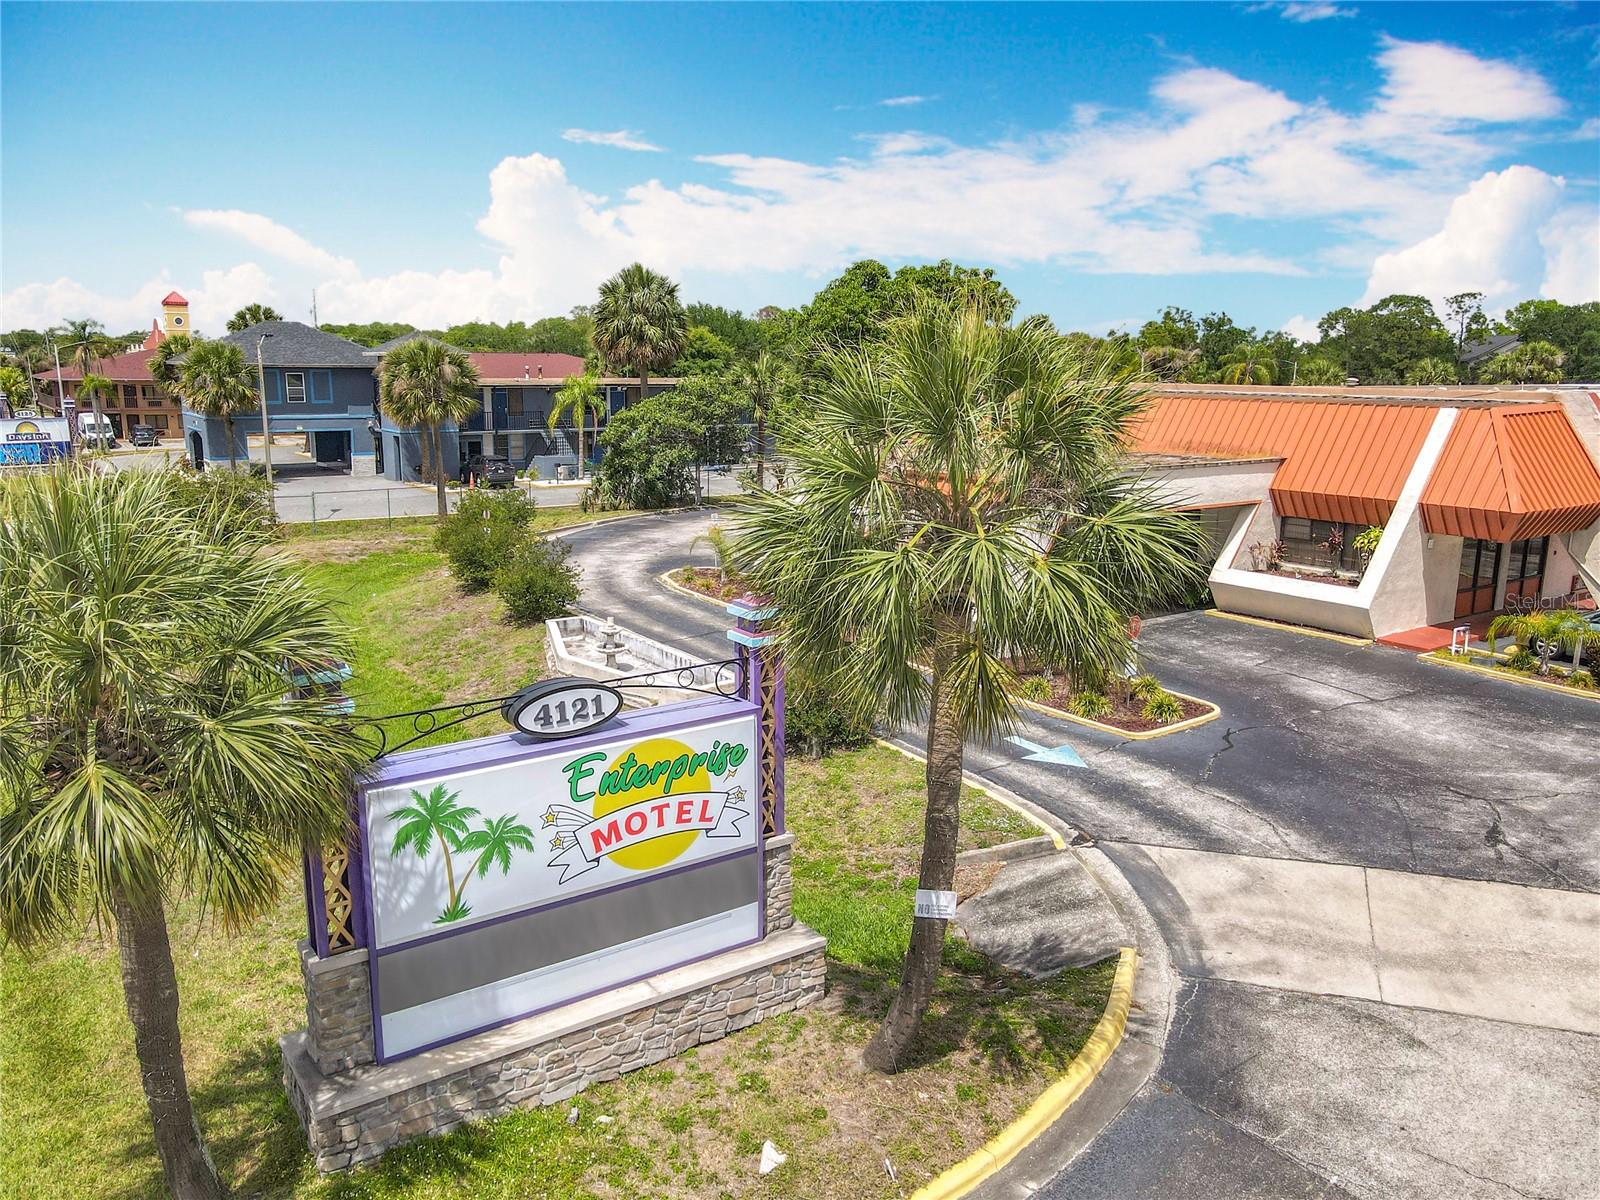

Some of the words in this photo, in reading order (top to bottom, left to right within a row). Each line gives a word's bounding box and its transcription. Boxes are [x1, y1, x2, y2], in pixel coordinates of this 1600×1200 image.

[534, 694, 606, 730] 4121
[562, 740, 748, 802] Enterprise
[590, 799, 714, 854] MOTEL
[917, 903, 930, 914] NO
